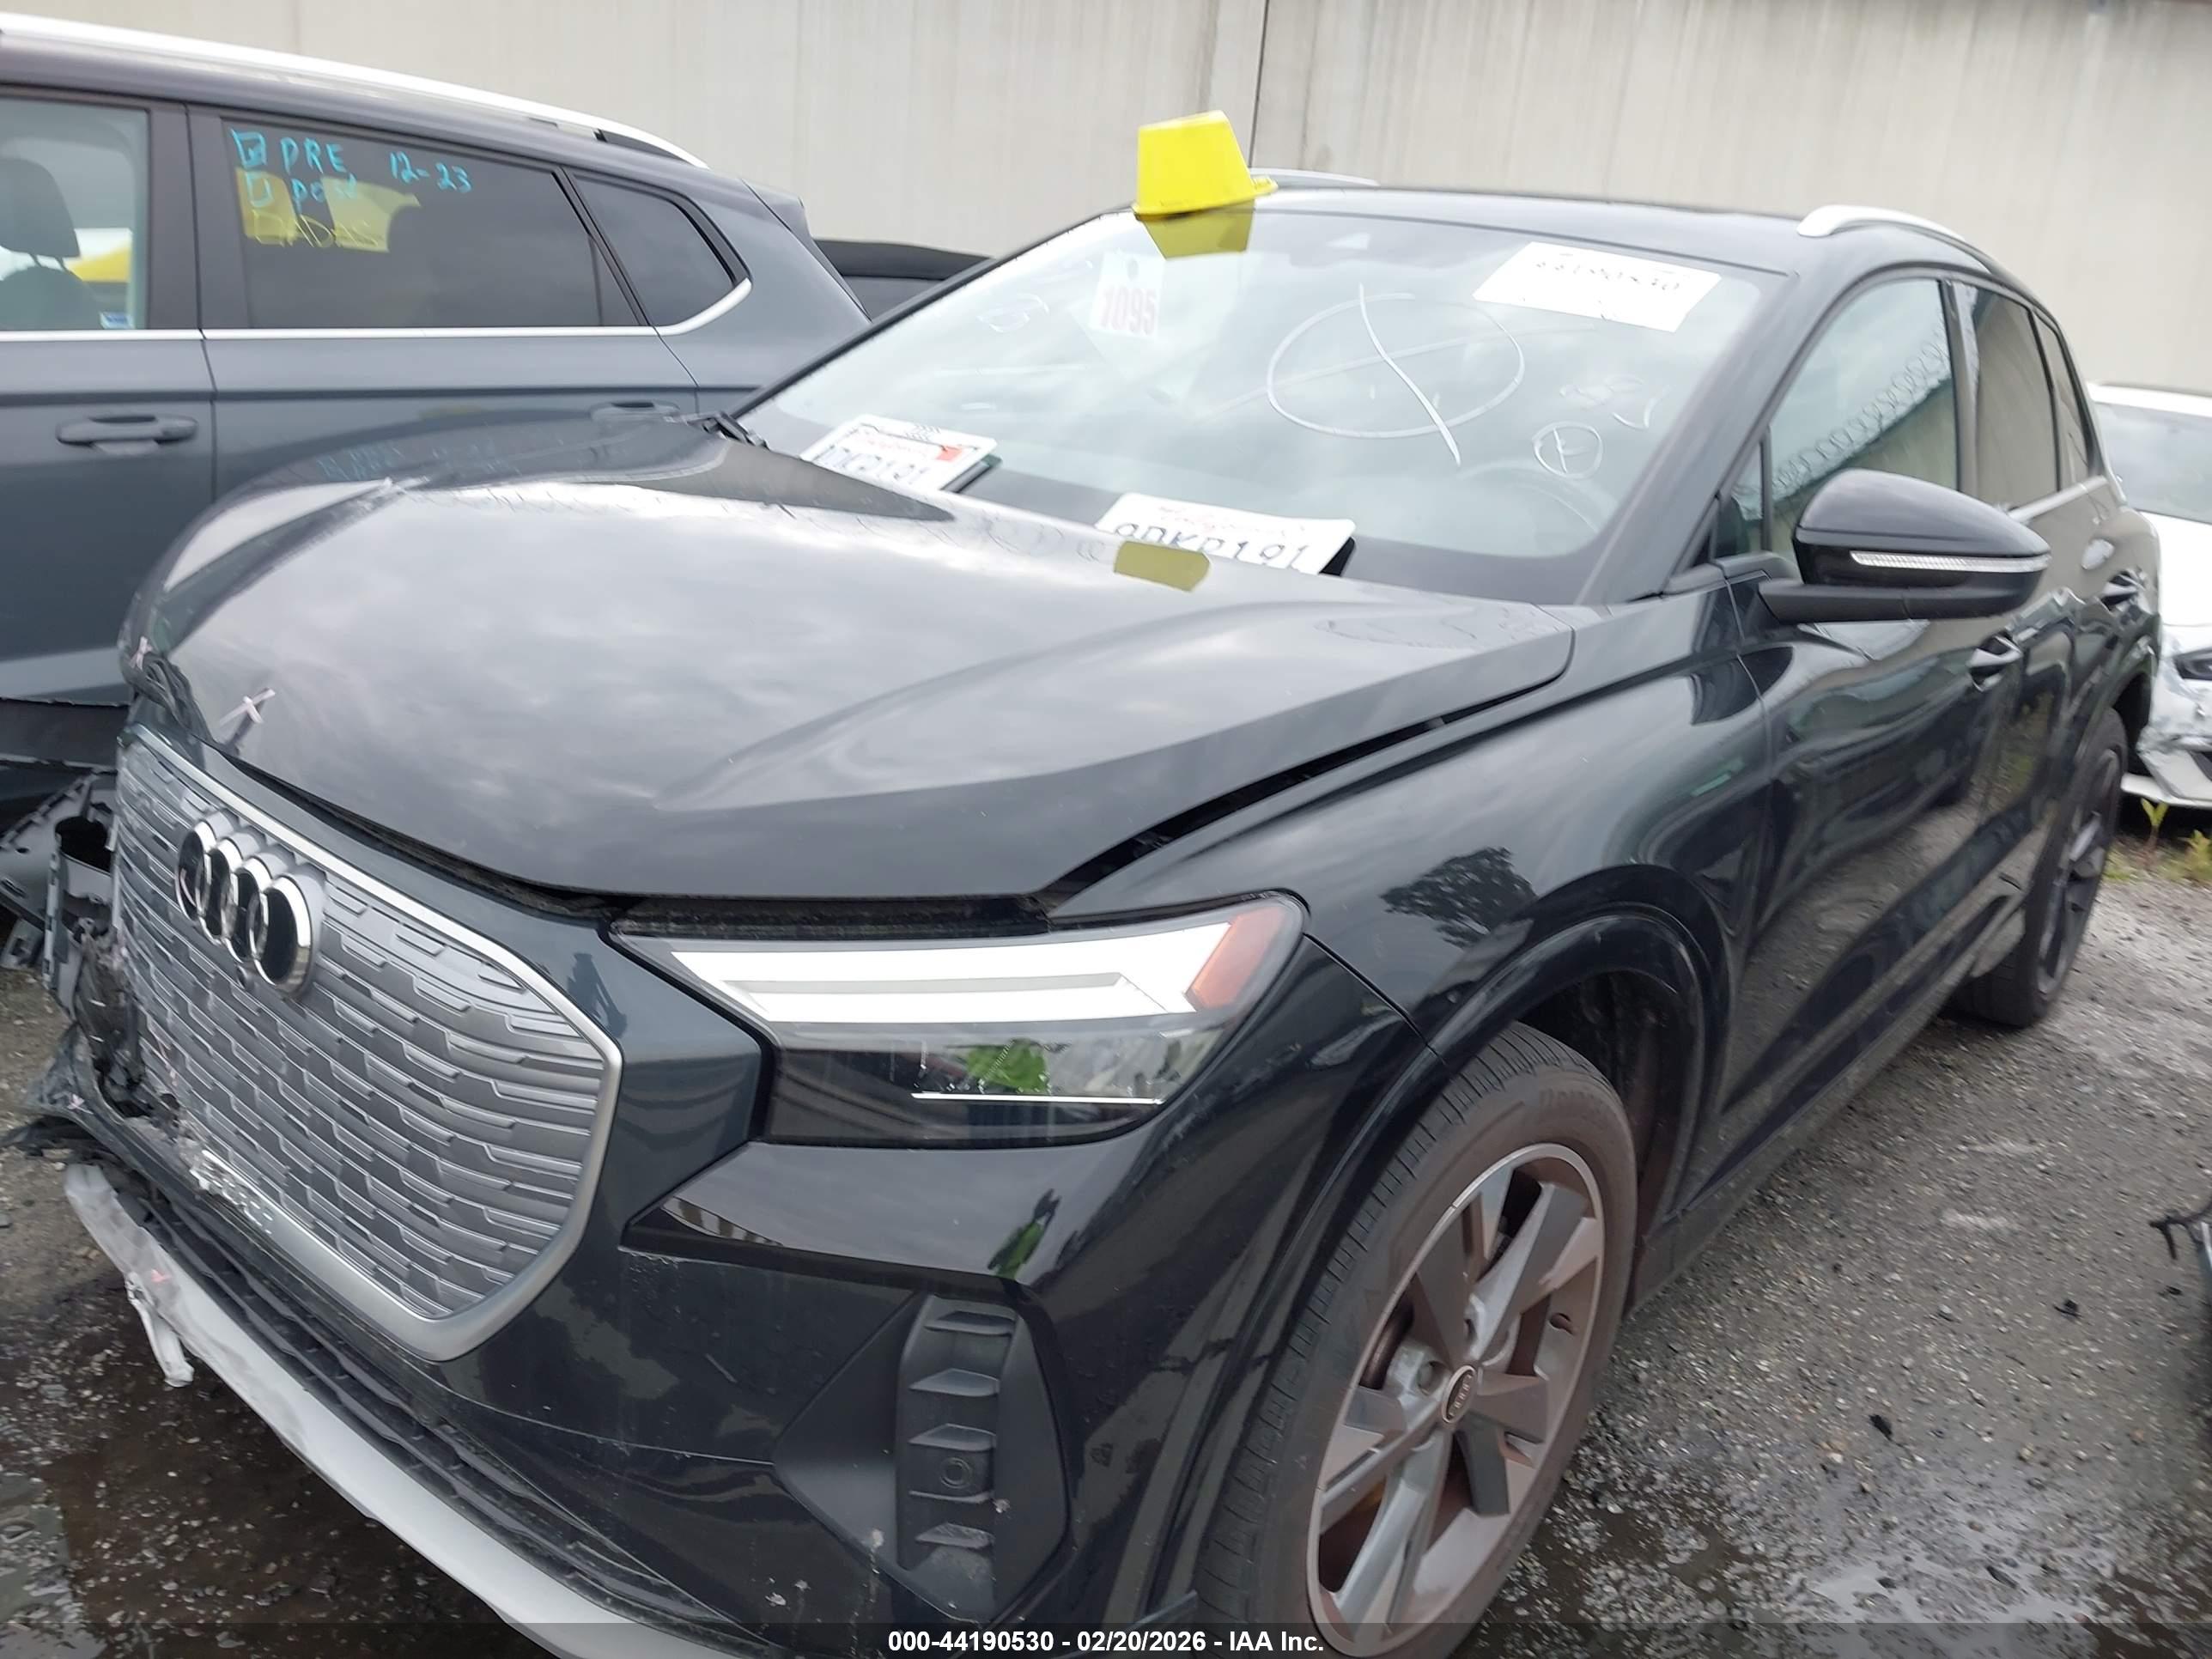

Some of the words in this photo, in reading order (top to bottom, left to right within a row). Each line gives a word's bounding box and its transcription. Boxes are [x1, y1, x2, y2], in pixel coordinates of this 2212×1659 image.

[280, 136, 347, 176] PRE
[389, 150, 472, 193] 12-23
[1100, 285, 1155, 336] 1095
